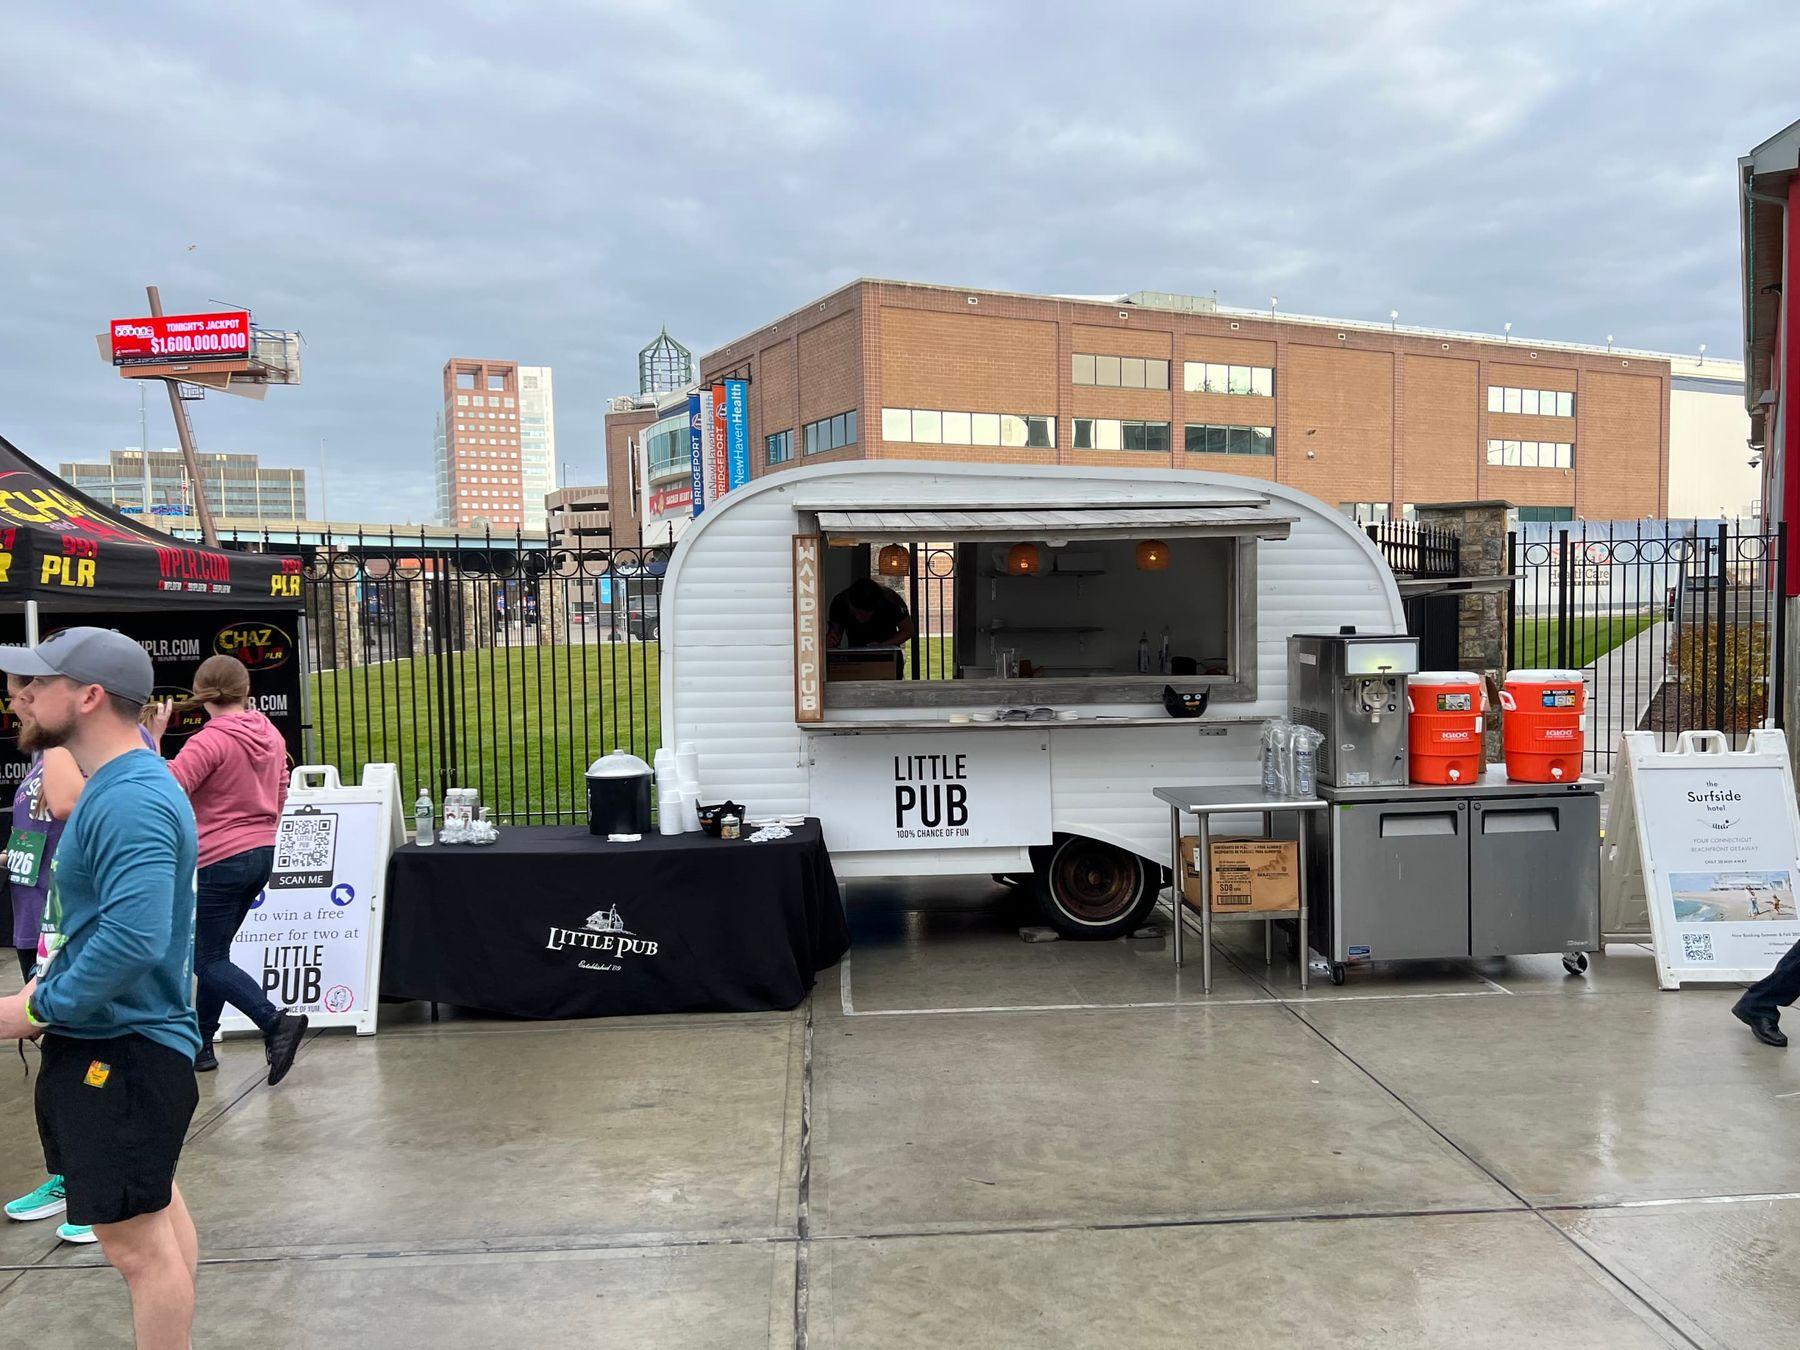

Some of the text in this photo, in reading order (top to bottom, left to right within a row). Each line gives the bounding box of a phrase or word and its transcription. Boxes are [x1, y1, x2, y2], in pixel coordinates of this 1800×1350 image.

[166, 319, 239, 332] TONIGHT'S JACKPOT
[151, 333, 246, 354] $1,600,000,000
[692, 436, 701, 505] BRIDGEPORT
[41, 554, 96, 588] PLR
[156, 547, 230, 582] WPLR.COM
[270, 574, 300, 597] PLR
[219, 629, 271, 649] CHAZ
[798, 546, 816, 711] WANDER PUB
[1546, 729, 1573, 737] IGLOO
[894, 754, 967, 781] LITTLE
[895, 784, 969, 828] PUB
[1687, 789, 1742, 803] Surfside
[897, 828, 970, 838] 100% CHANCE OF FUN
[279, 875, 323, 885] SCAN ME
[254, 908, 344, 922] to win a free
[235, 928, 359, 942] dinner for two at
[545, 927, 658, 958] LITTLE PUB
[264, 945, 324, 968] LITTLE
[578, 960, 610, 970] Established
[262, 967, 322, 1005] PUB
